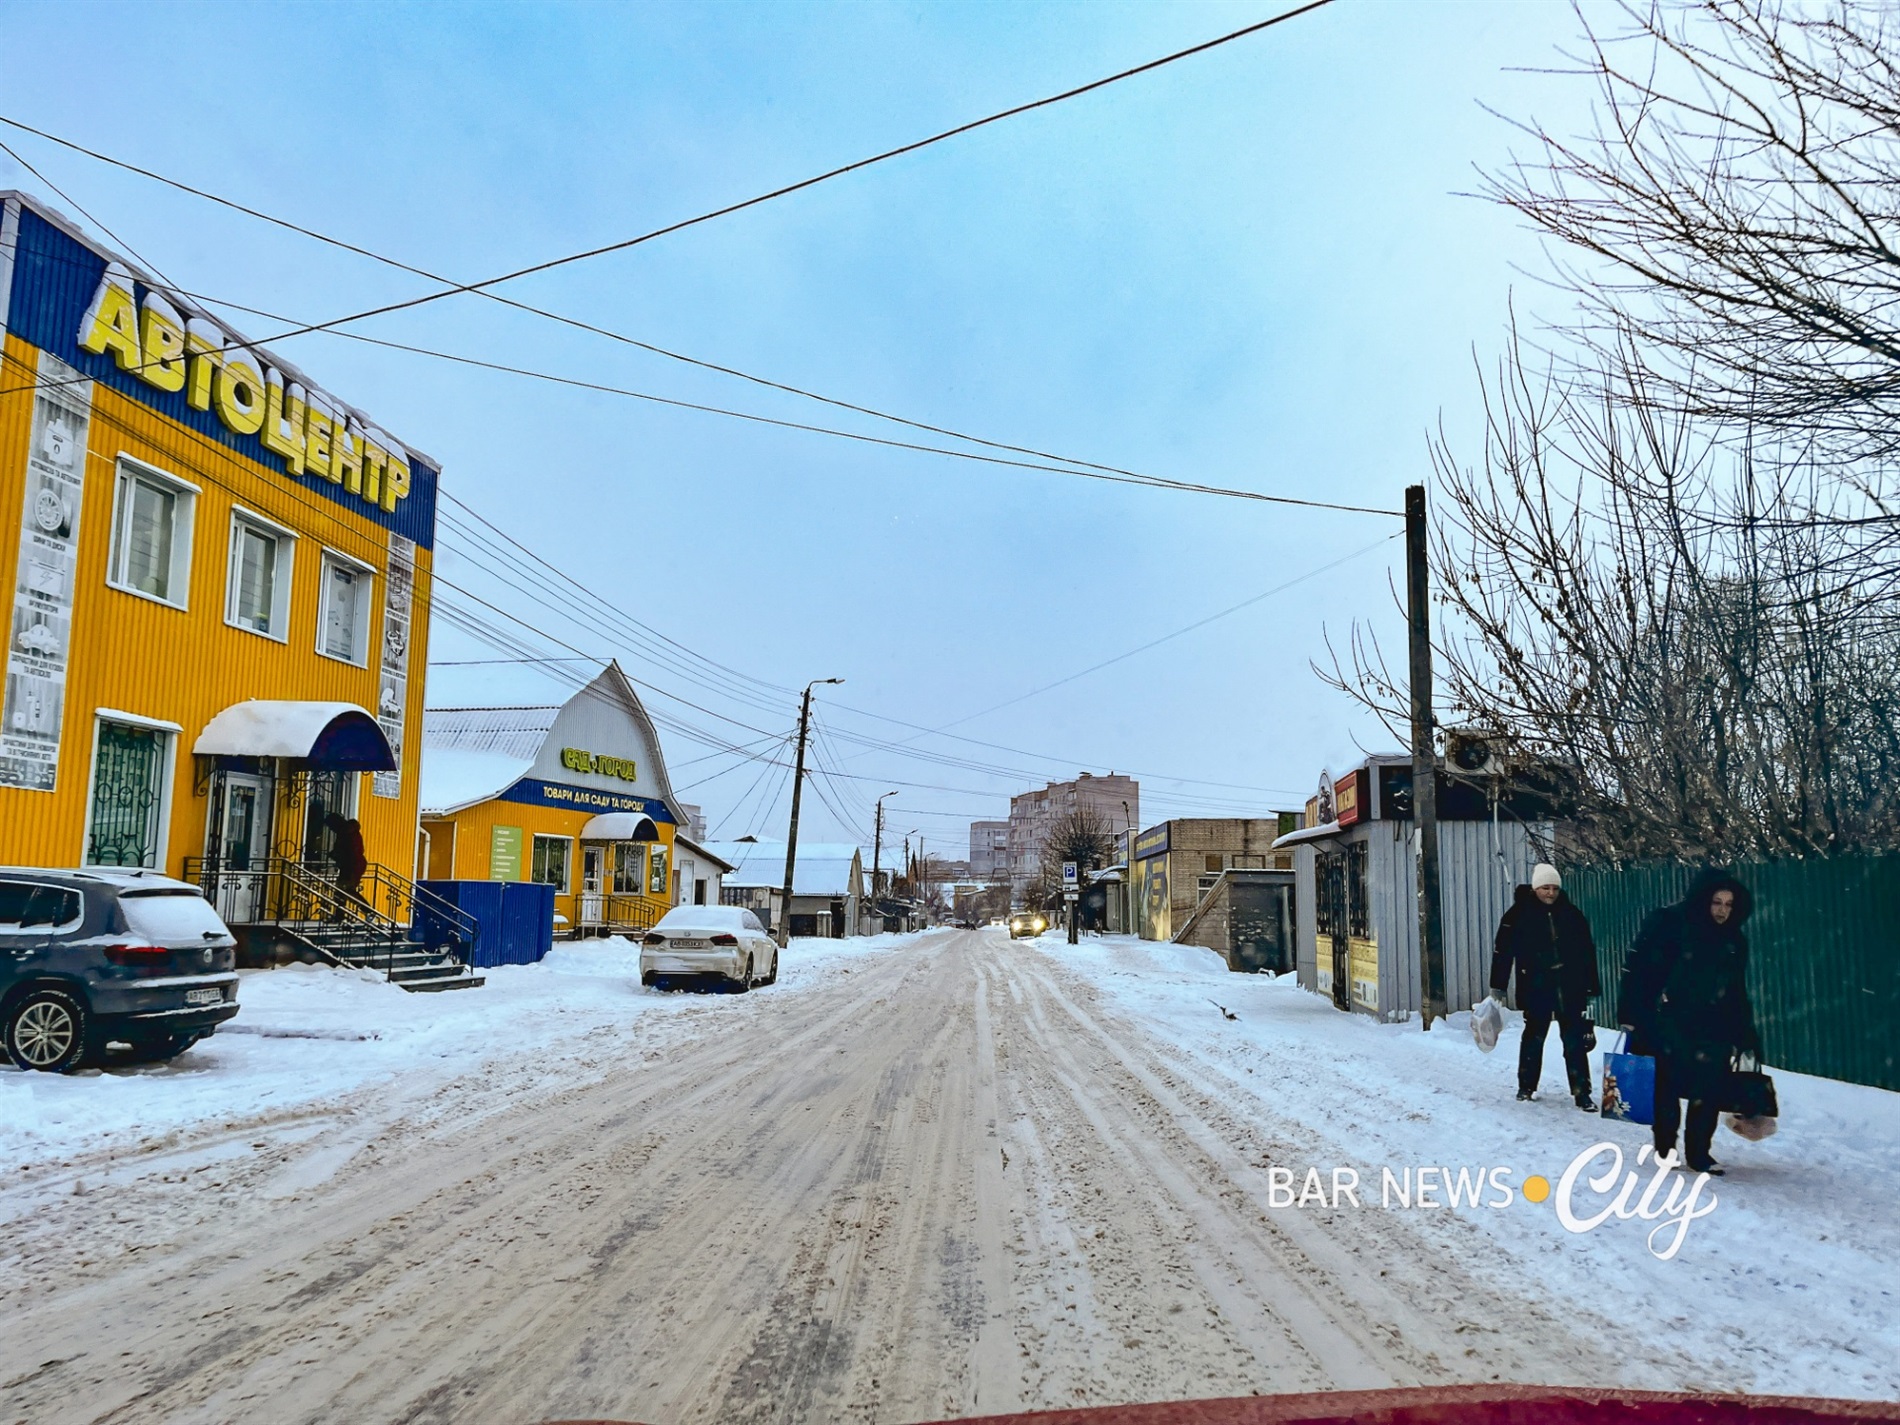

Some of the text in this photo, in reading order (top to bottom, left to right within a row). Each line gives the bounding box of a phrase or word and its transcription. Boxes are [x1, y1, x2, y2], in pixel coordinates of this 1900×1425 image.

[78, 263, 411, 513] АВТОЦЕНТР
[561, 747, 637, 782] САД ГОРОД
[543, 786, 645, 811] ТОВАРИ ДЛЯ САДУ ТА ГОРОДУ
